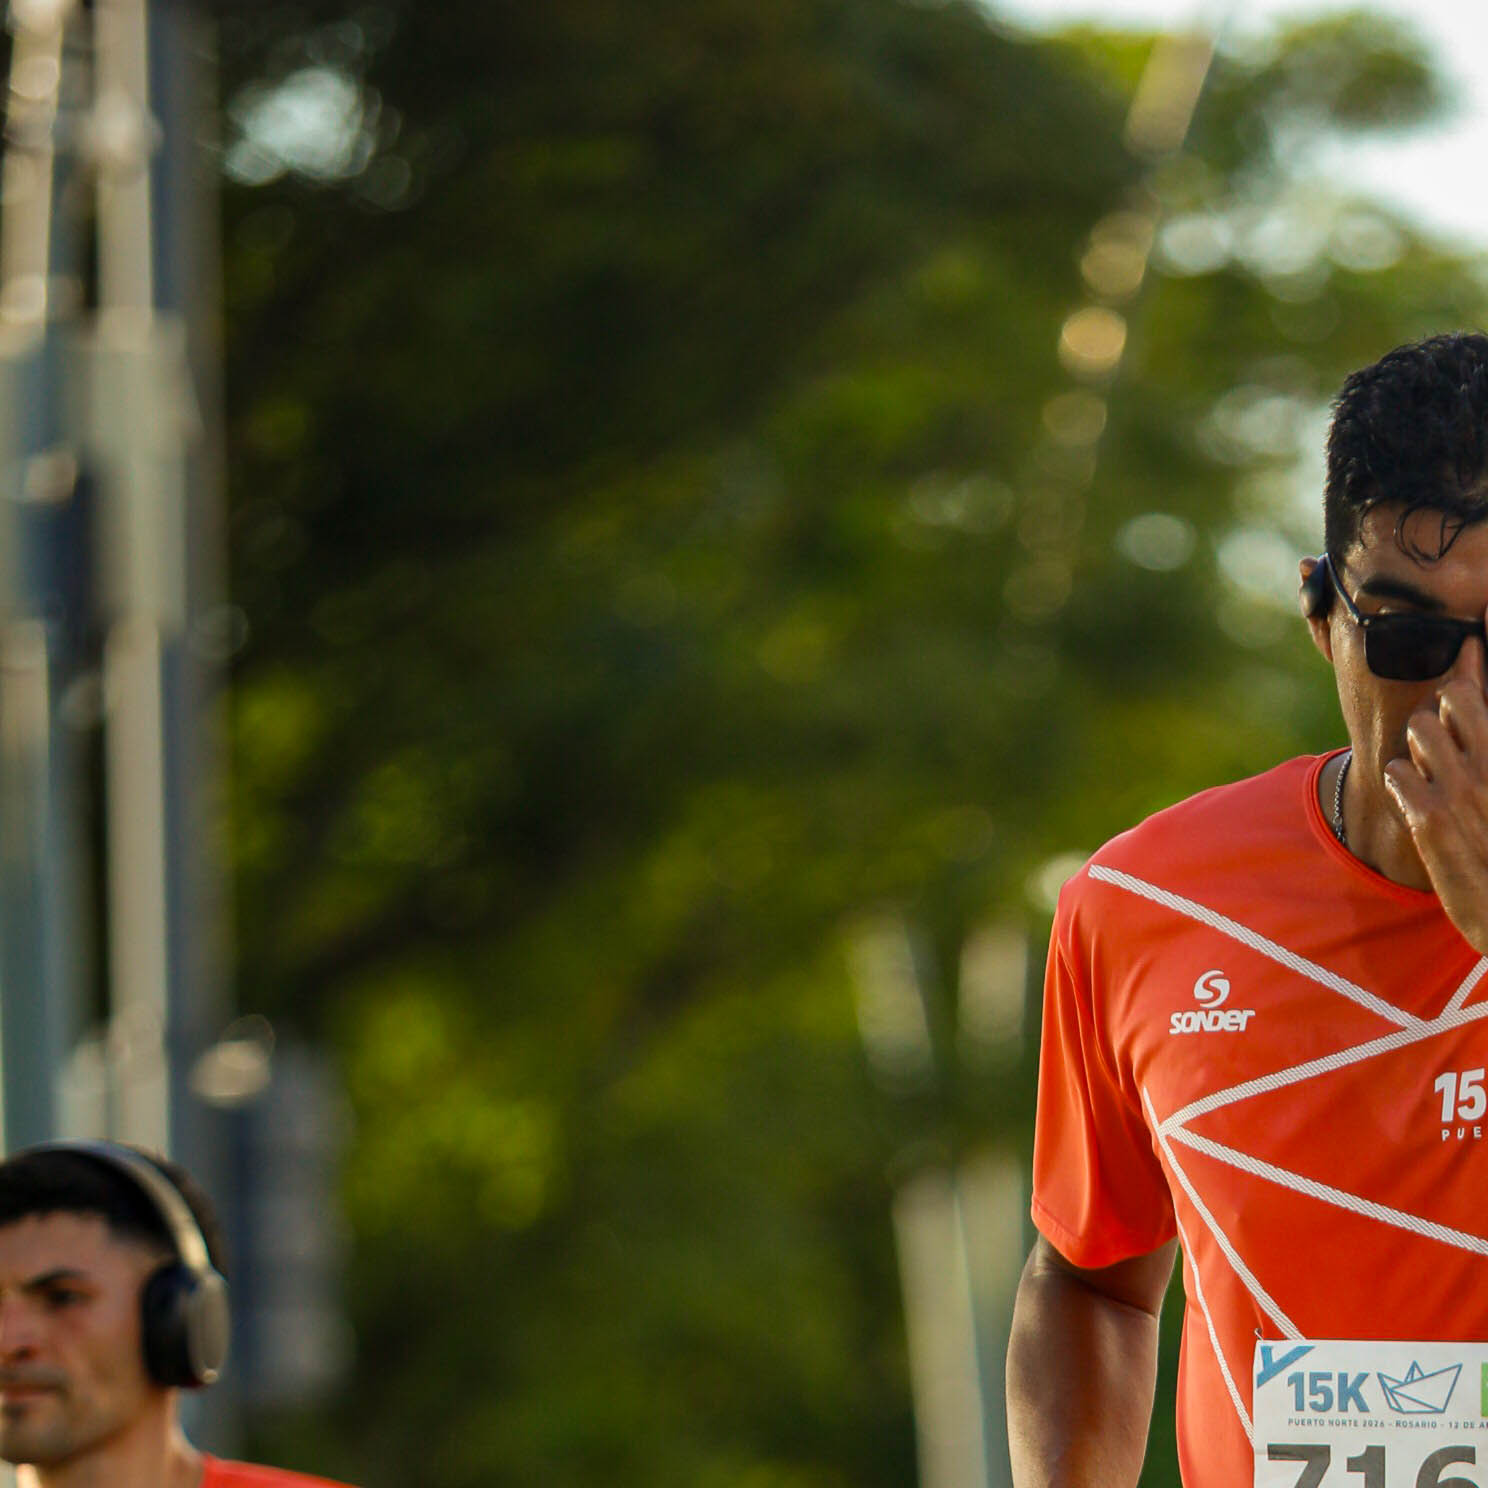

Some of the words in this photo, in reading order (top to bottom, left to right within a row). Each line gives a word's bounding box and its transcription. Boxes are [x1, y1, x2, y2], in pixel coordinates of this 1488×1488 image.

[1287, 1371, 1370, 1413] 15K
[1288, 1417, 1325, 1426] PUERTO
[1328, 1418, 1359, 1427] NORTE
[1363, 1419, 1385, 1428] 2026
[1395, 1420, 1437, 1429] ROSARIO
[1449, 1421, 1459, 1429] 12
[1463, 1421, 1475, 1429] DE
